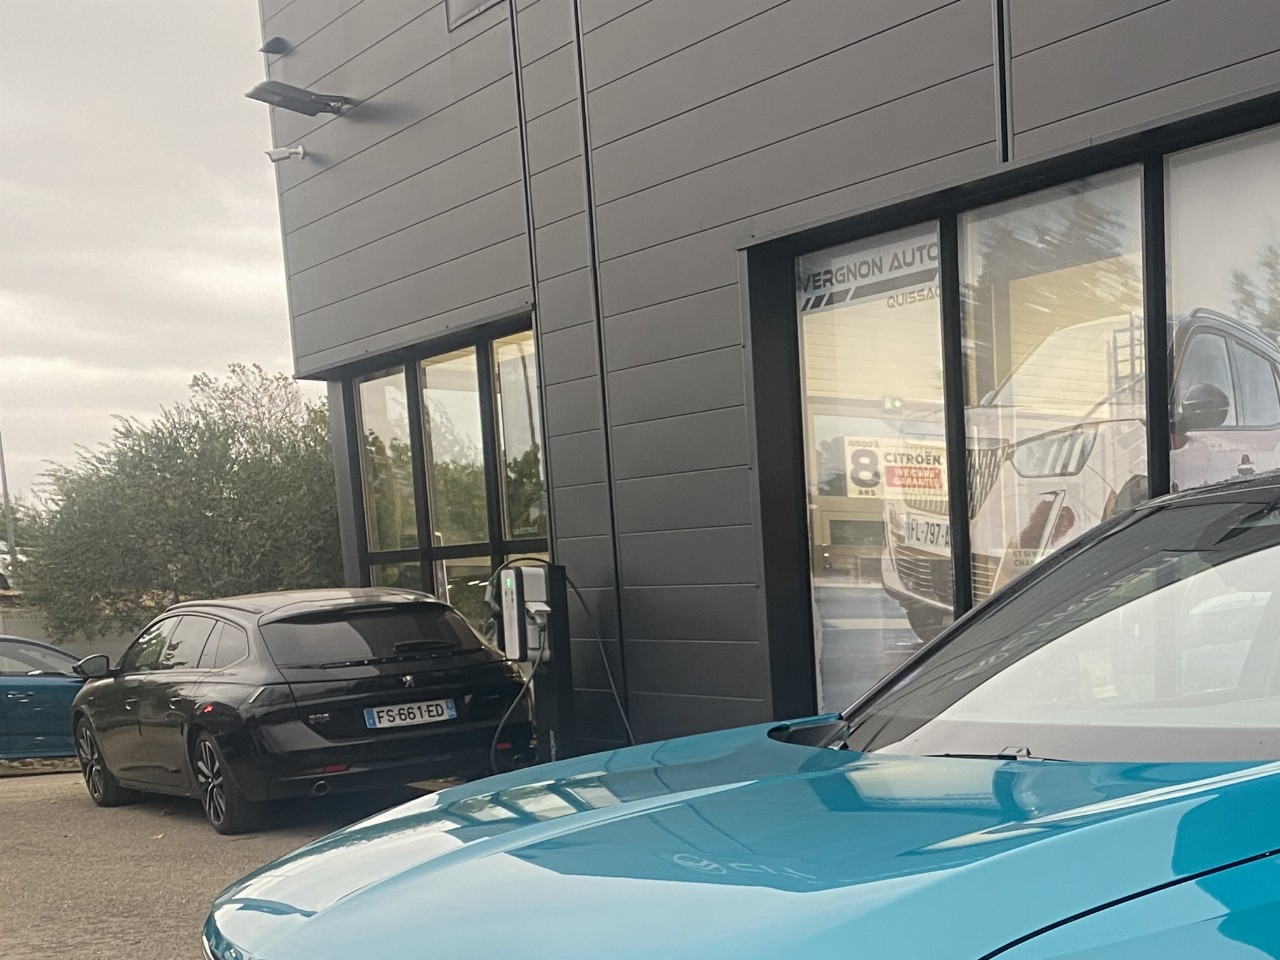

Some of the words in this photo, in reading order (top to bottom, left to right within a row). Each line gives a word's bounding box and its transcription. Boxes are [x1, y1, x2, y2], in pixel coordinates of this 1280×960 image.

[798, 257, 884, 294] VERGNON
[850, 448, 881, 489] 8
[884, 451, 941, 466] CITROËN
[376, 703, 444, 724] FS-661-ED
